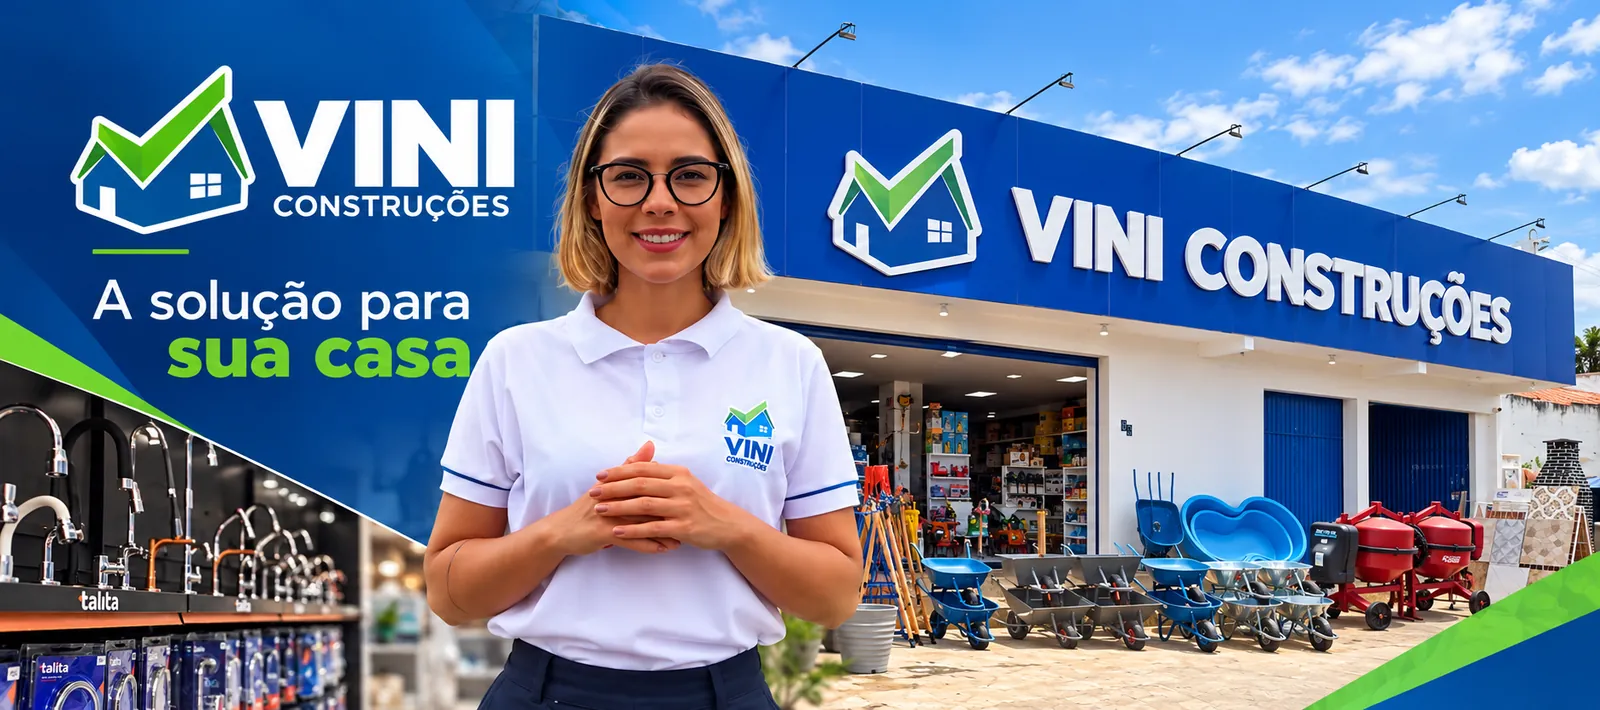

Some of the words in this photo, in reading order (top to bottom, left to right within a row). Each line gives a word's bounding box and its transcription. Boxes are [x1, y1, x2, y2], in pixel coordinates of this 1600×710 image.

[1010, 186, 1163, 282] VINI
[1184, 227, 1512, 346] CONSTRUÇÕES
[724, 436, 774, 465] VINI
[81, 590, 119, 611] talita
[41, 661, 69, 674] talita
